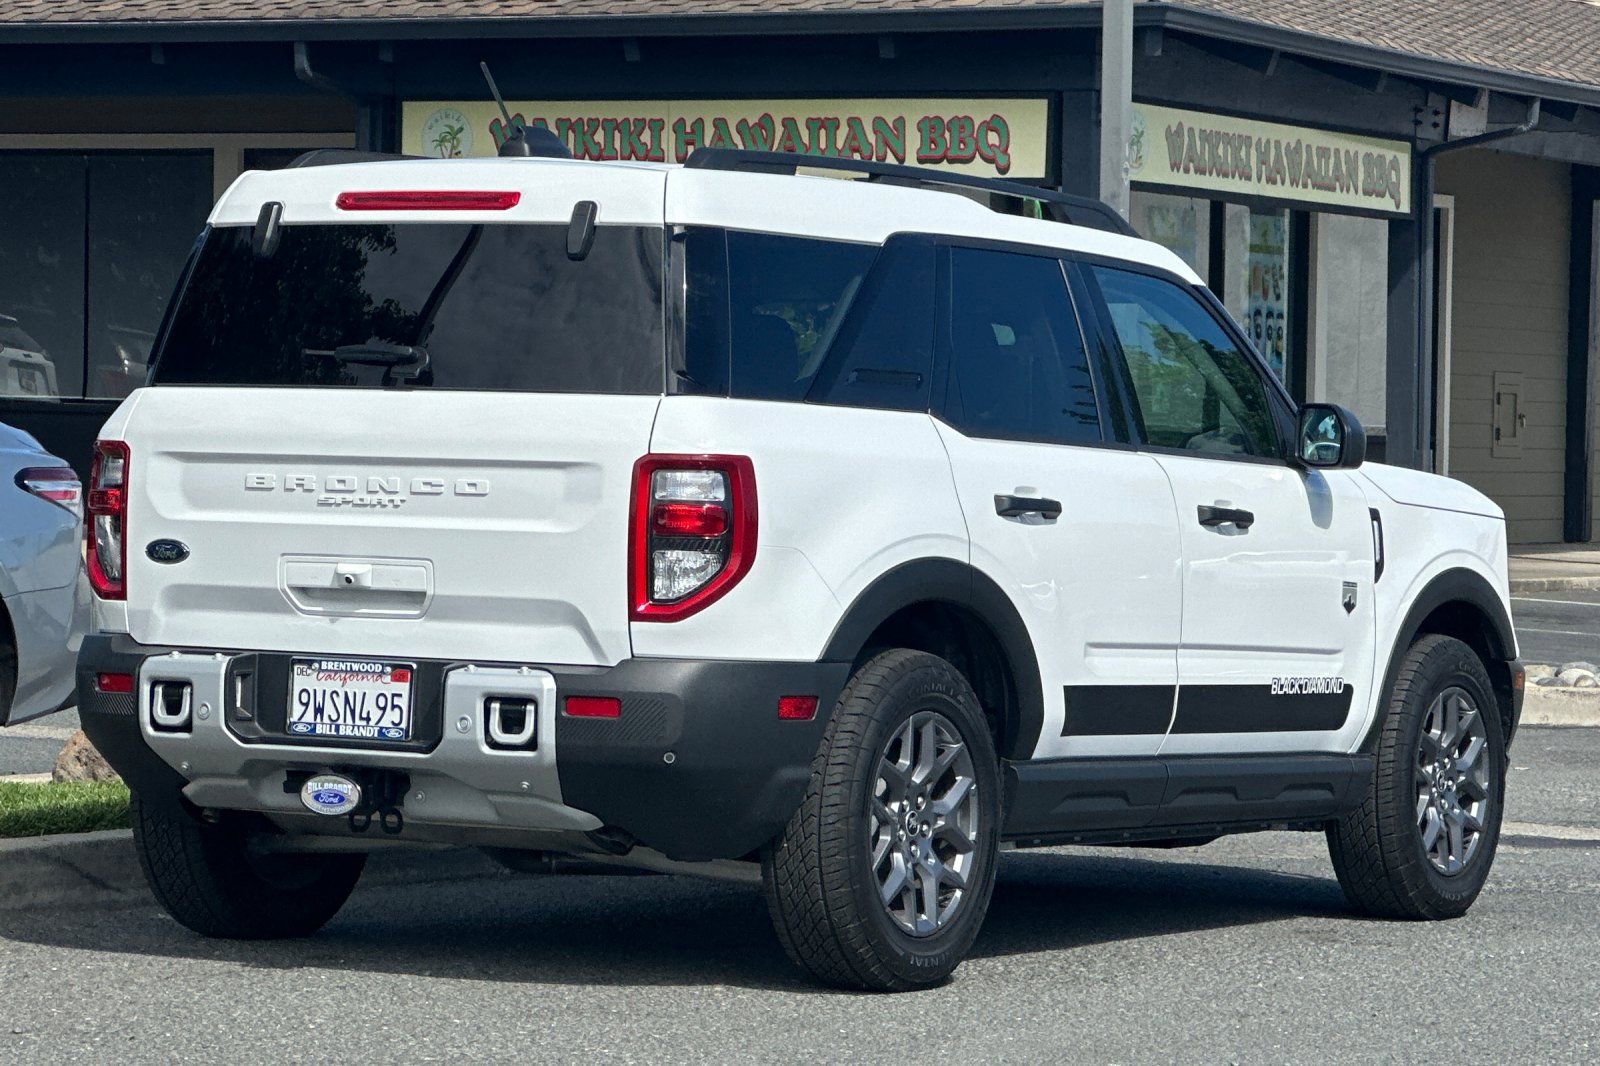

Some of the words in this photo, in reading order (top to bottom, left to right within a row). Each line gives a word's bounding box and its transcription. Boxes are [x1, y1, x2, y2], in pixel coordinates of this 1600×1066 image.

[489, 113, 665, 161] WIKIKI
[917, 114, 1010, 175] BBQ
[1165, 121, 1253, 181] WAIKIKI
[1255, 137, 1358, 196] HAWAIIAN
[1361, 151, 1402, 211] BBQ
[245, 473, 490, 497] BRONCO
[317, 494, 406, 508] SPORT
[154, 545, 178, 559] Ford
[296, 666, 311, 676] DEC
[321, 660, 382, 673] BRENTWOOD
[316, 671, 391, 687] California
[1271, 677, 1301, 695] BLACK
[1302, 677, 1345, 695] DIAMOND
[297, 688, 404, 727] 9WSN495
[316, 724, 336, 735] BILL
[339, 725, 380, 738] BRANDT
[307, 781, 322, 793] BILL
[318, 792, 340, 803] Ford
